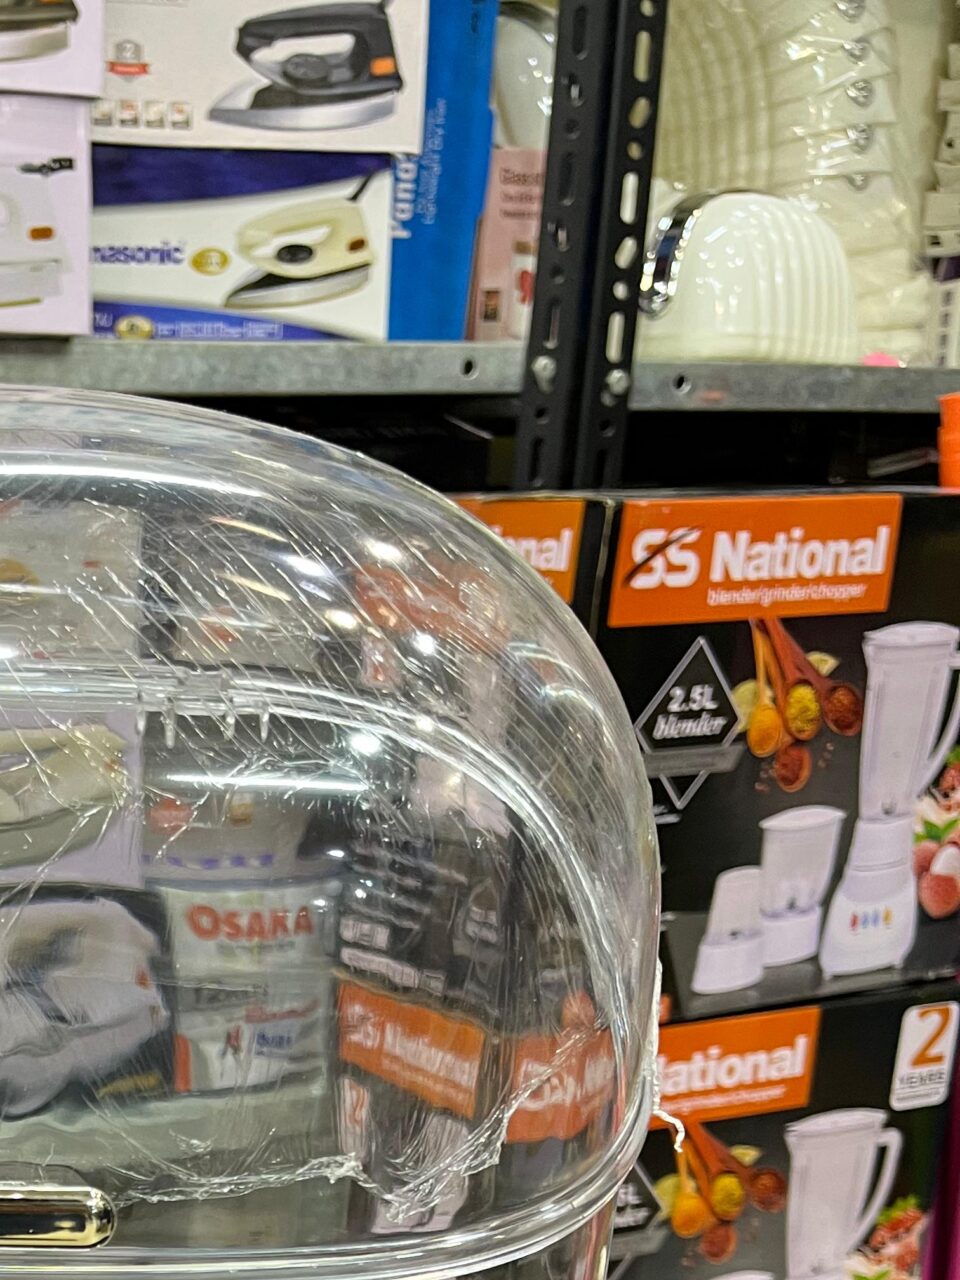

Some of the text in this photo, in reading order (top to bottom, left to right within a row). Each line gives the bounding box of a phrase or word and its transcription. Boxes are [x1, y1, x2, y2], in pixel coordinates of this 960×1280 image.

[390, 152, 418, 240] Pana
[709, 525, 891, 584] National
[667, 684, 720, 713] 2.5L
[652, 711, 728, 741] blender
[186, 905, 315, 943] OSAKA
[910, 1006, 951, 1067] 2
